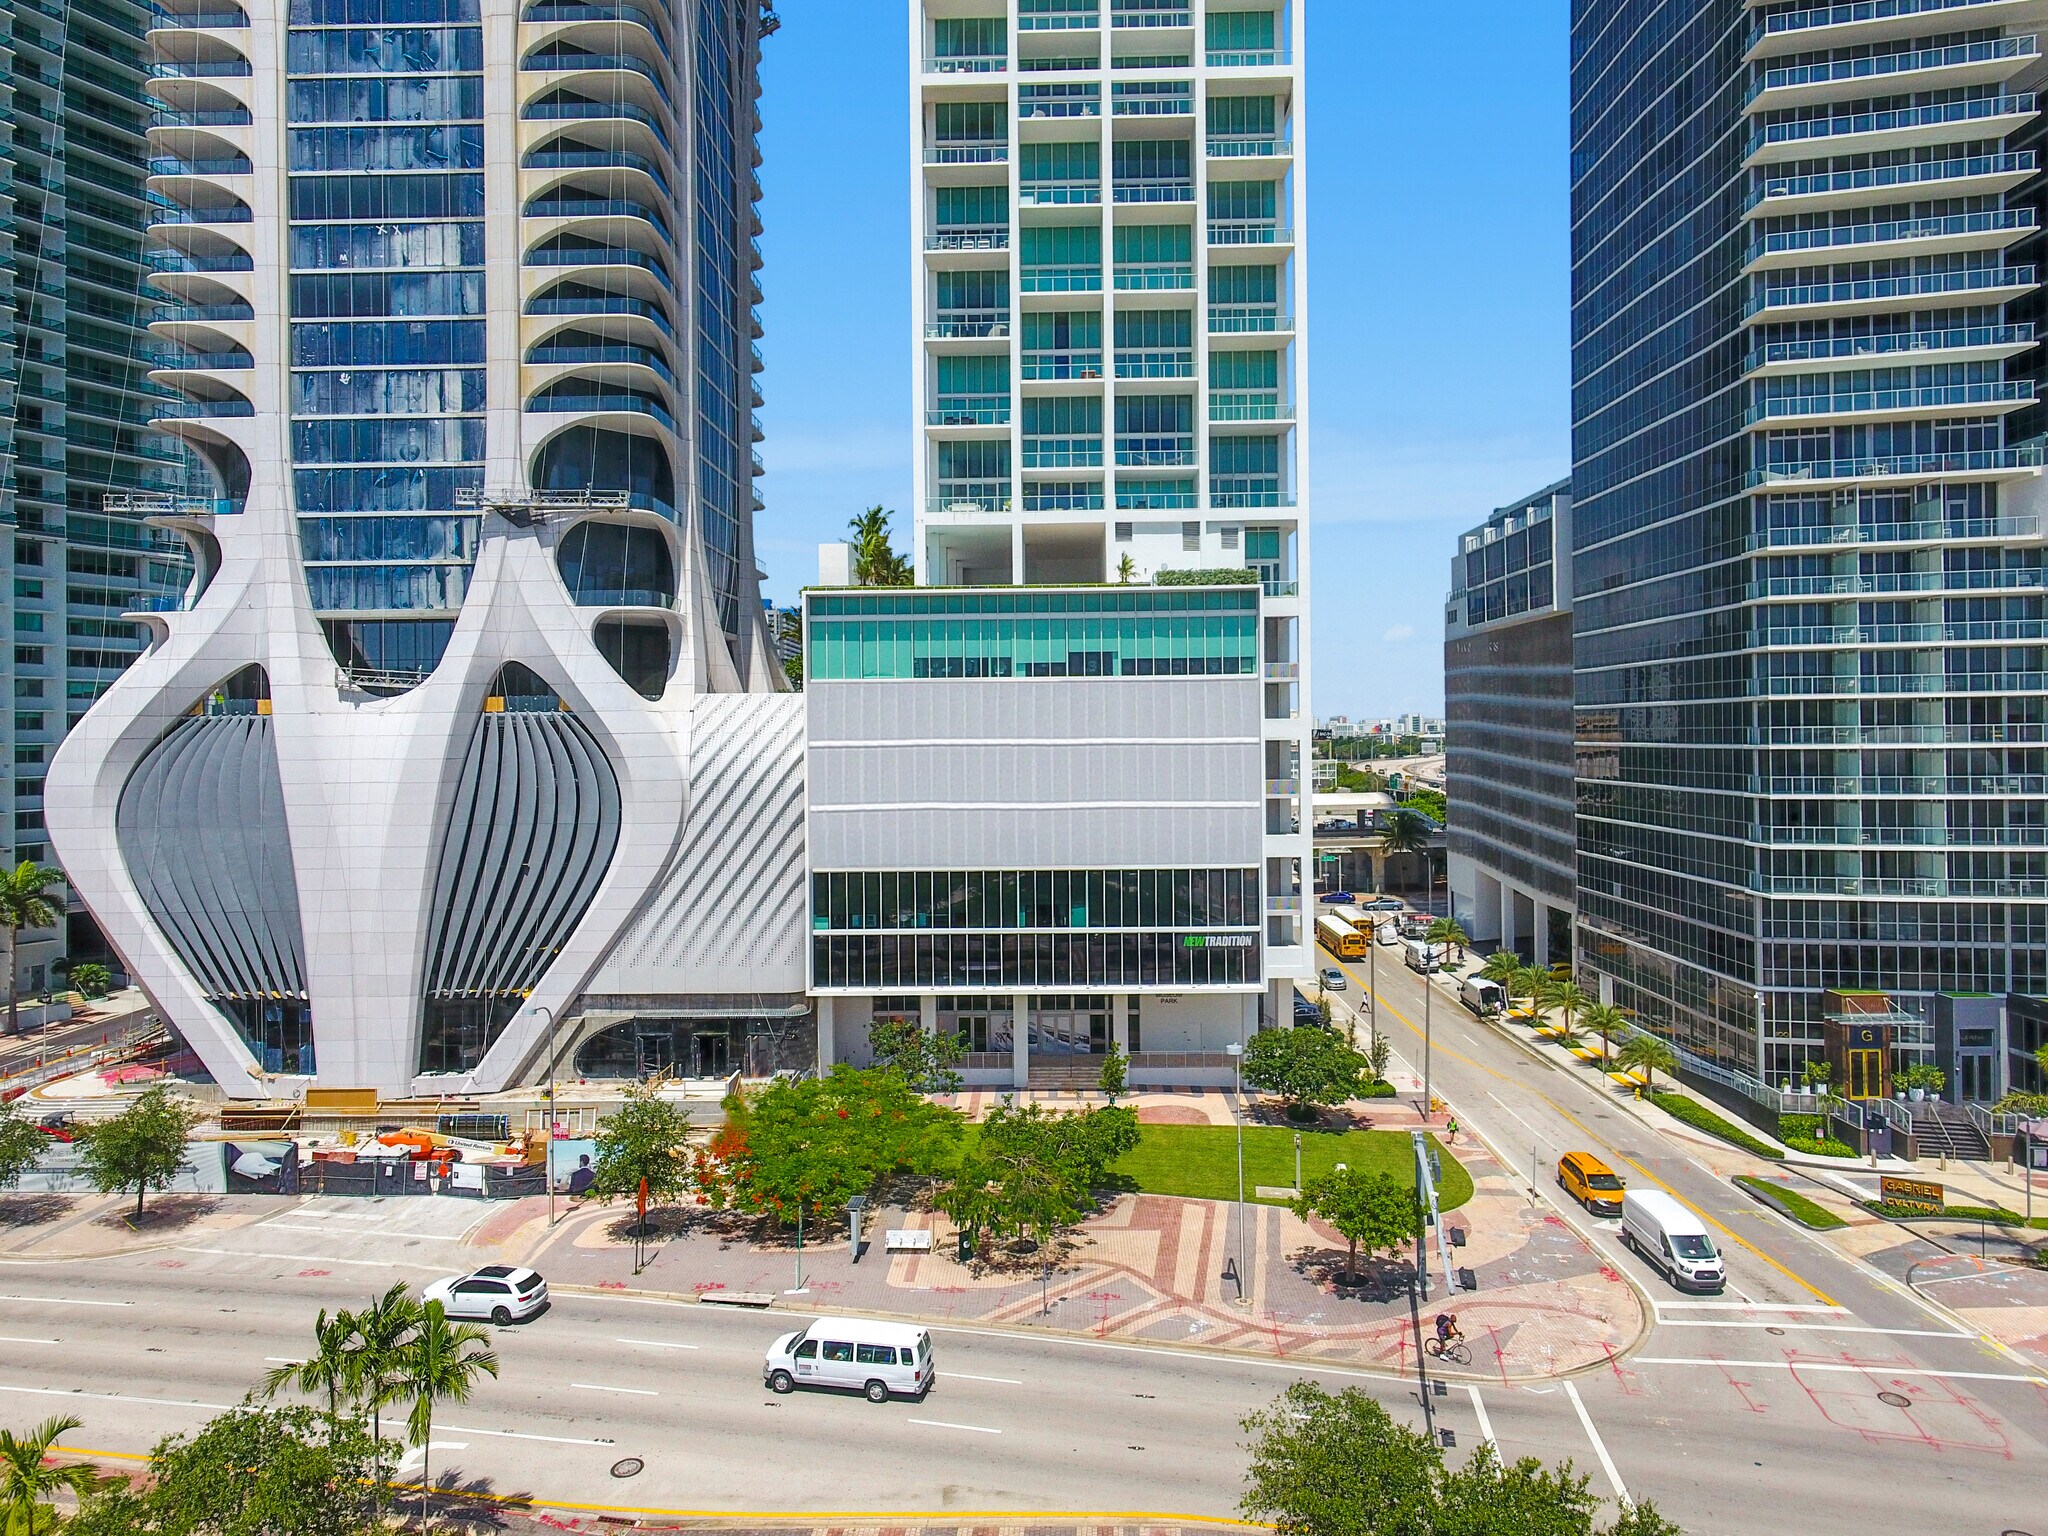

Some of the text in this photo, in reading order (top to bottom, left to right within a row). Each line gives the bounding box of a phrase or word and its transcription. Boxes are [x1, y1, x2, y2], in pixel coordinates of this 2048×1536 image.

[1183, 935, 1253, 947] NEWTRADITION
[1861, 1030, 1873, 1042] G
[455, 1140, 492, 1151] United Rentals
[1886, 1180, 1940, 1197] GABRIEL
[1886, 1197, 1939, 1213] CVLTVRA
